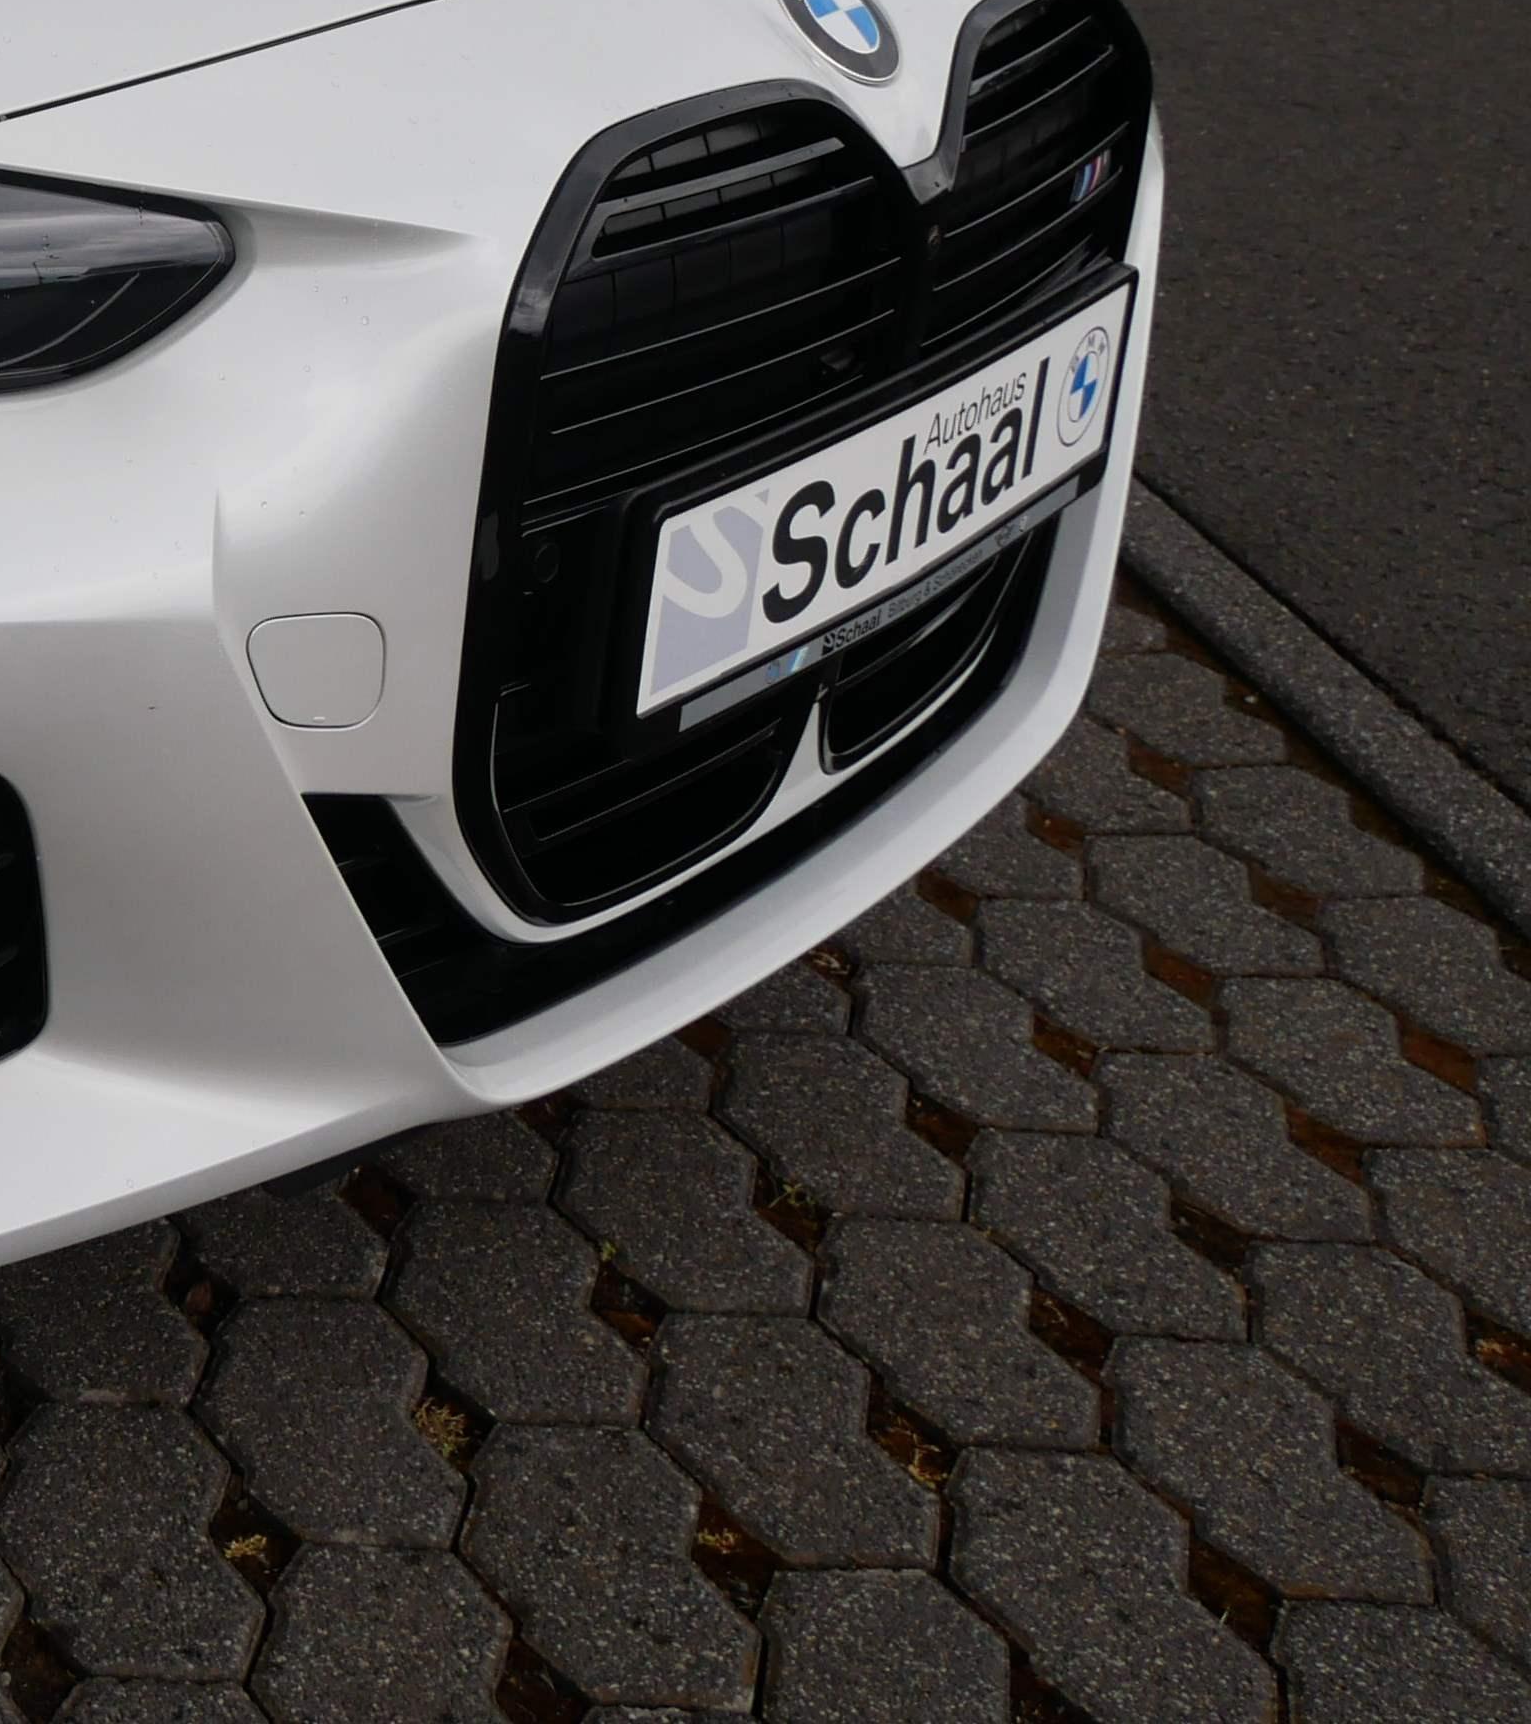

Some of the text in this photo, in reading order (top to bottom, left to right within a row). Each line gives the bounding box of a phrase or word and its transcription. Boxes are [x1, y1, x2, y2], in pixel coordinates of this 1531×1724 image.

[923, 372, 1027, 454] Autohaus
[762, 356, 1050, 624] Schaal
[836, 608, 882, 648] Schaal
